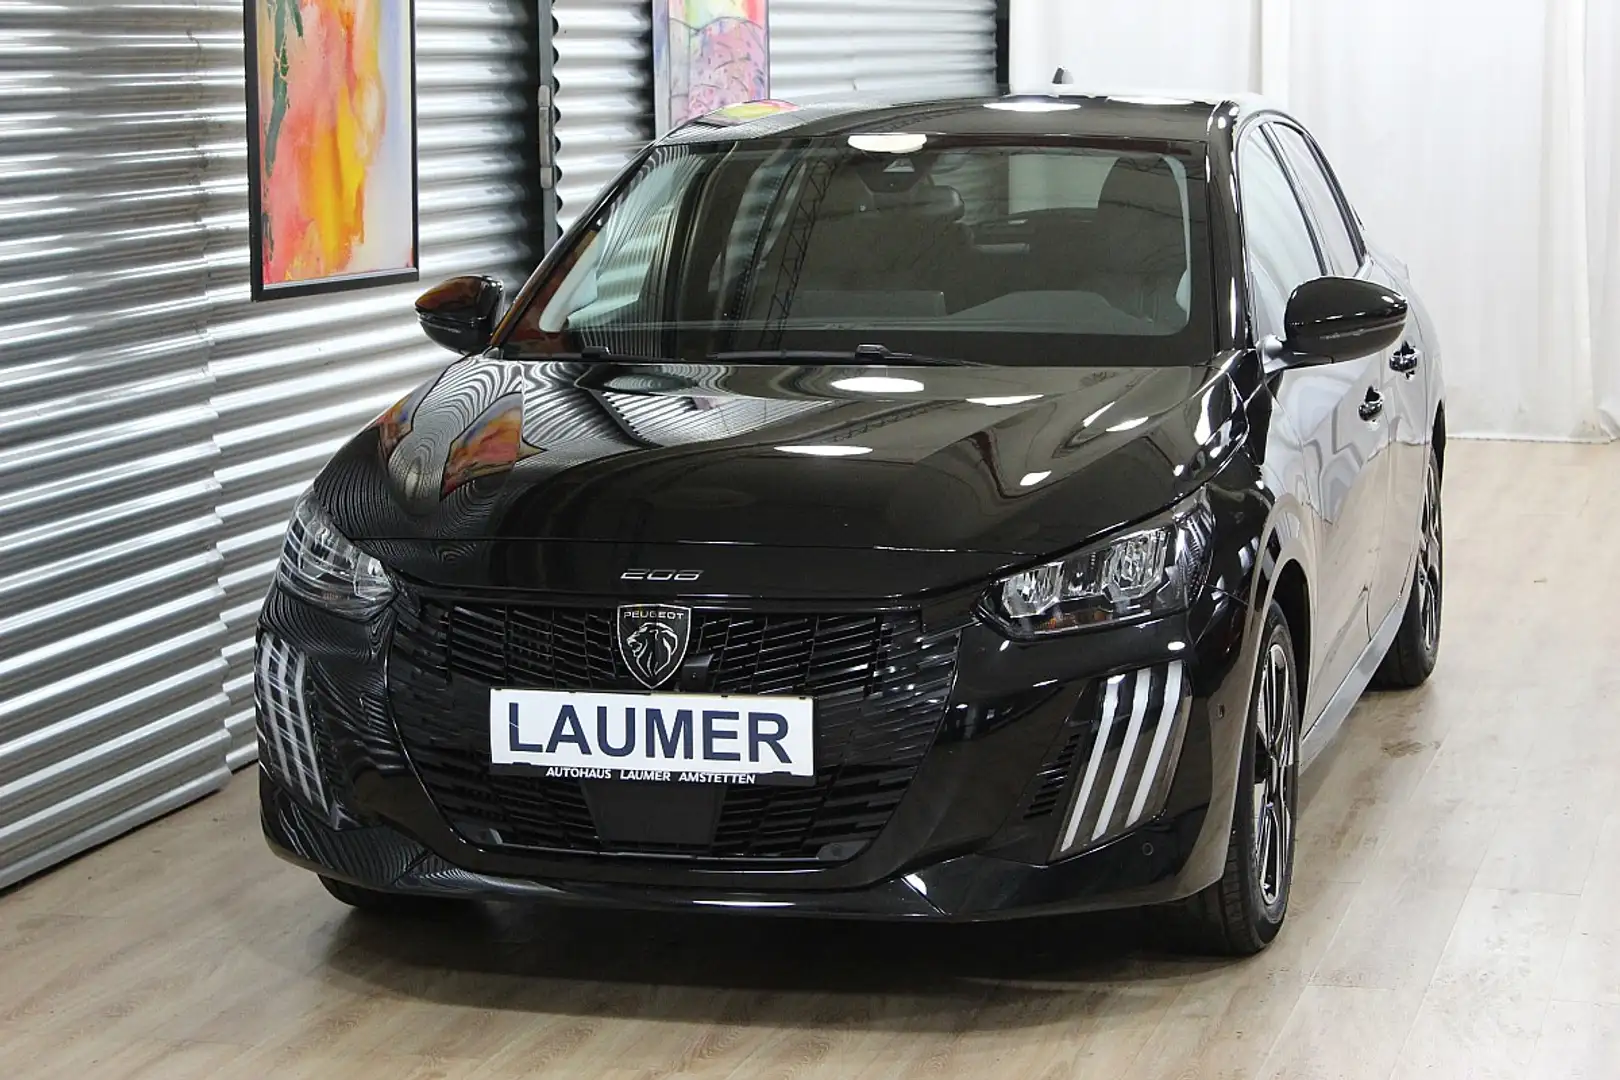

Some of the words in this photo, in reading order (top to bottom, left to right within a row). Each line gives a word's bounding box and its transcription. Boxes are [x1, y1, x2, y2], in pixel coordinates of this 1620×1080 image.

[620, 568, 704, 581] 208
[623, 611, 685, 620] PEUGEOT
[508, 702, 792, 764] LAUMER
[546, 766, 612, 780] AUTOHAUS
[620, 770, 671, 783] LAUMER
[679, 772, 756, 785] AMSTETTEN
